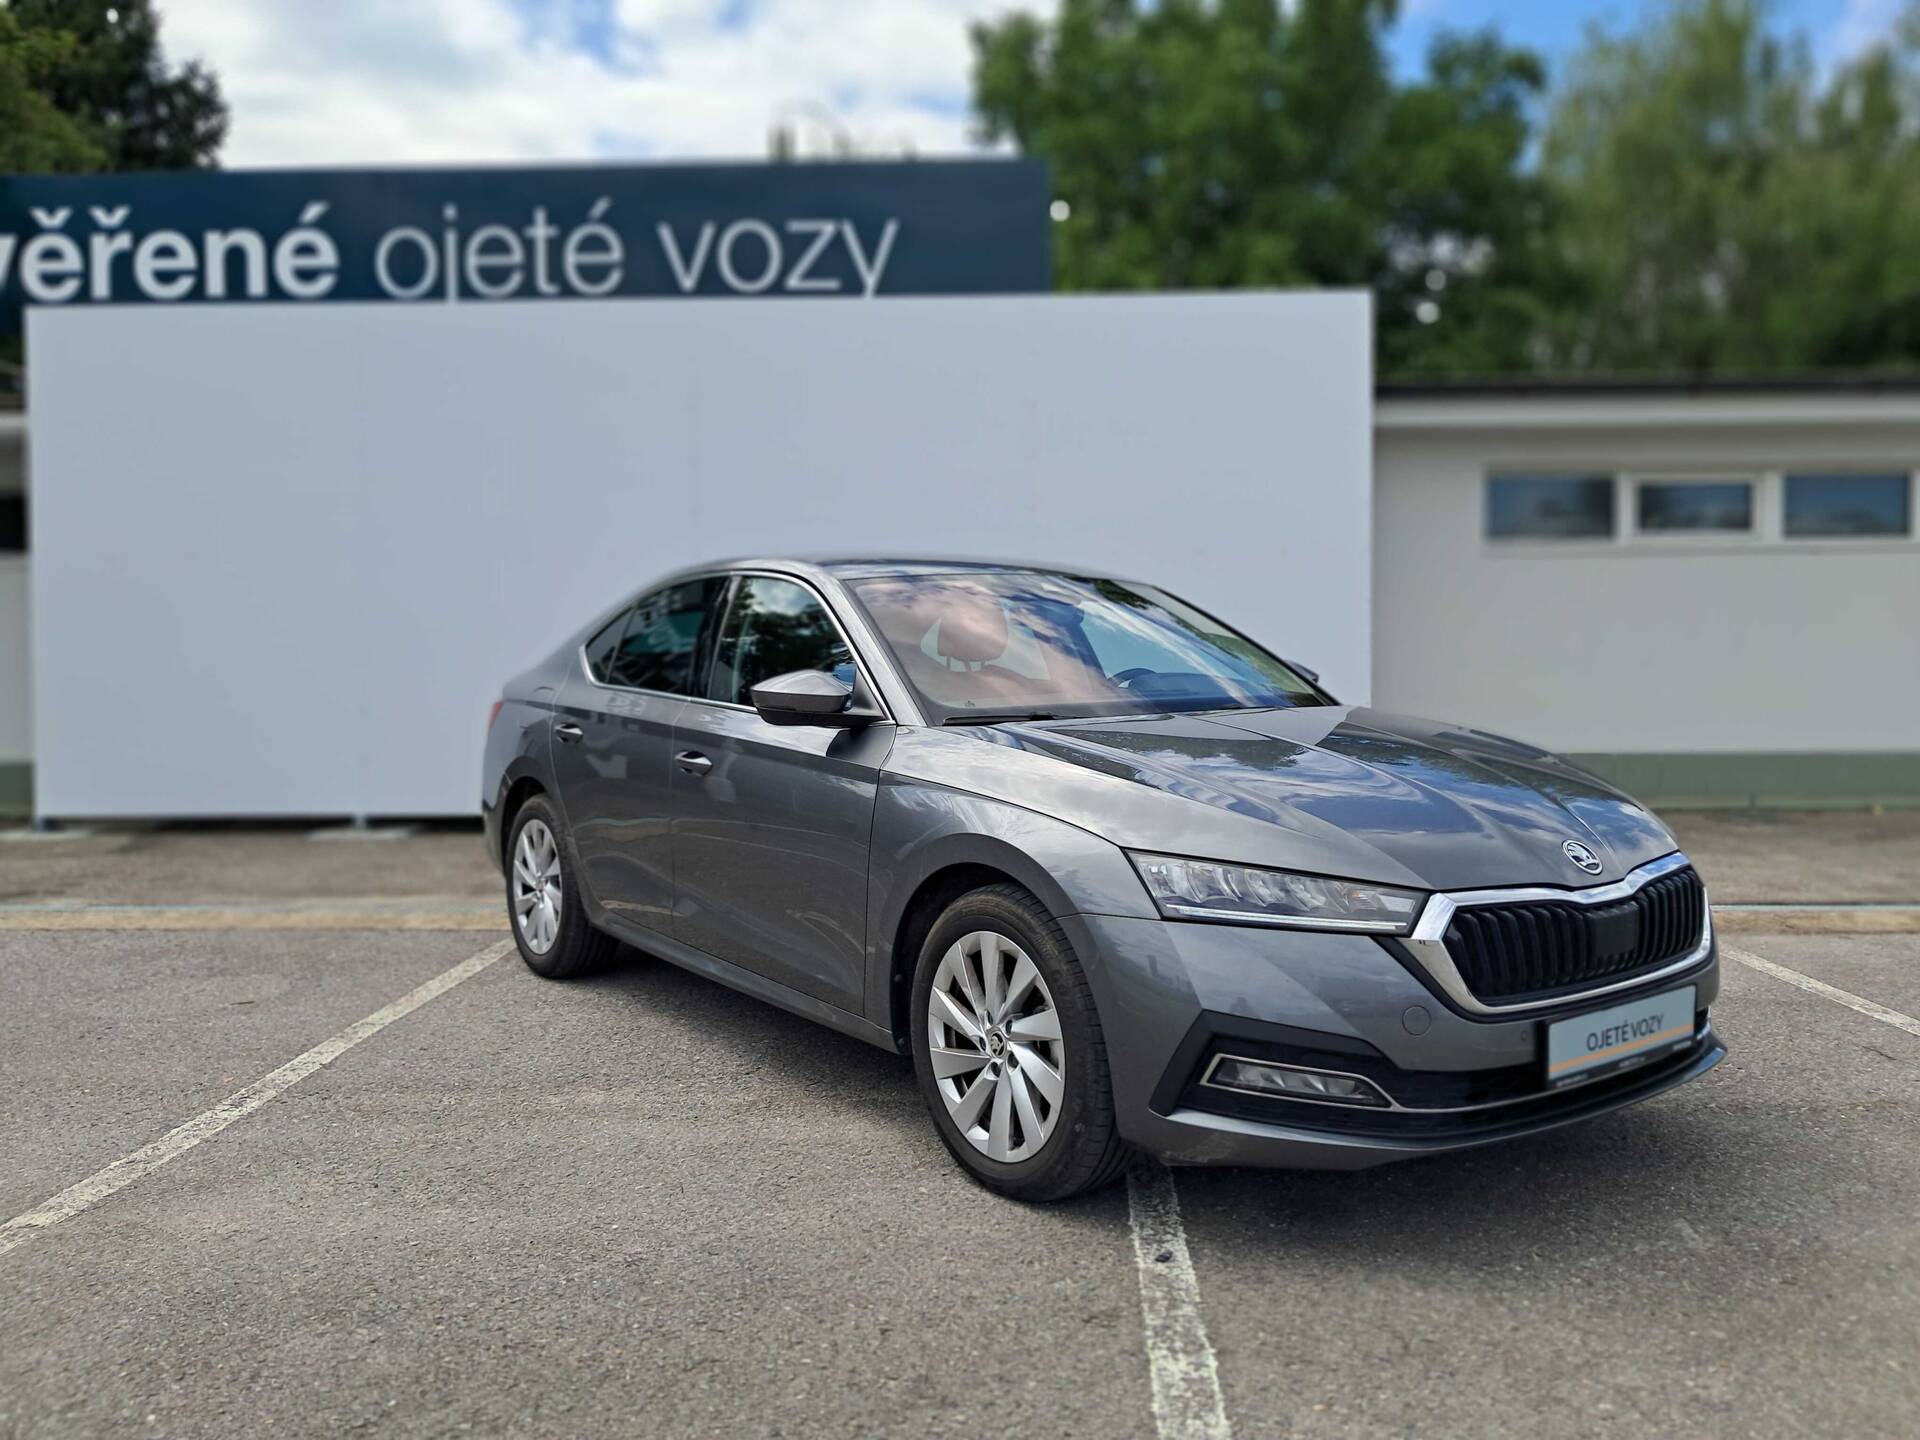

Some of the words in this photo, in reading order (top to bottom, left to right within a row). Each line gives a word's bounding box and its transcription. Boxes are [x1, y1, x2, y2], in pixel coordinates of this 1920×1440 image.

[374, 199, 624, 303] ojeté
[657, 218, 899, 301] vozy
[1587, 1020, 1630, 1051] OJETÉ
[1630, 1014, 1665, 1039] VOZY
